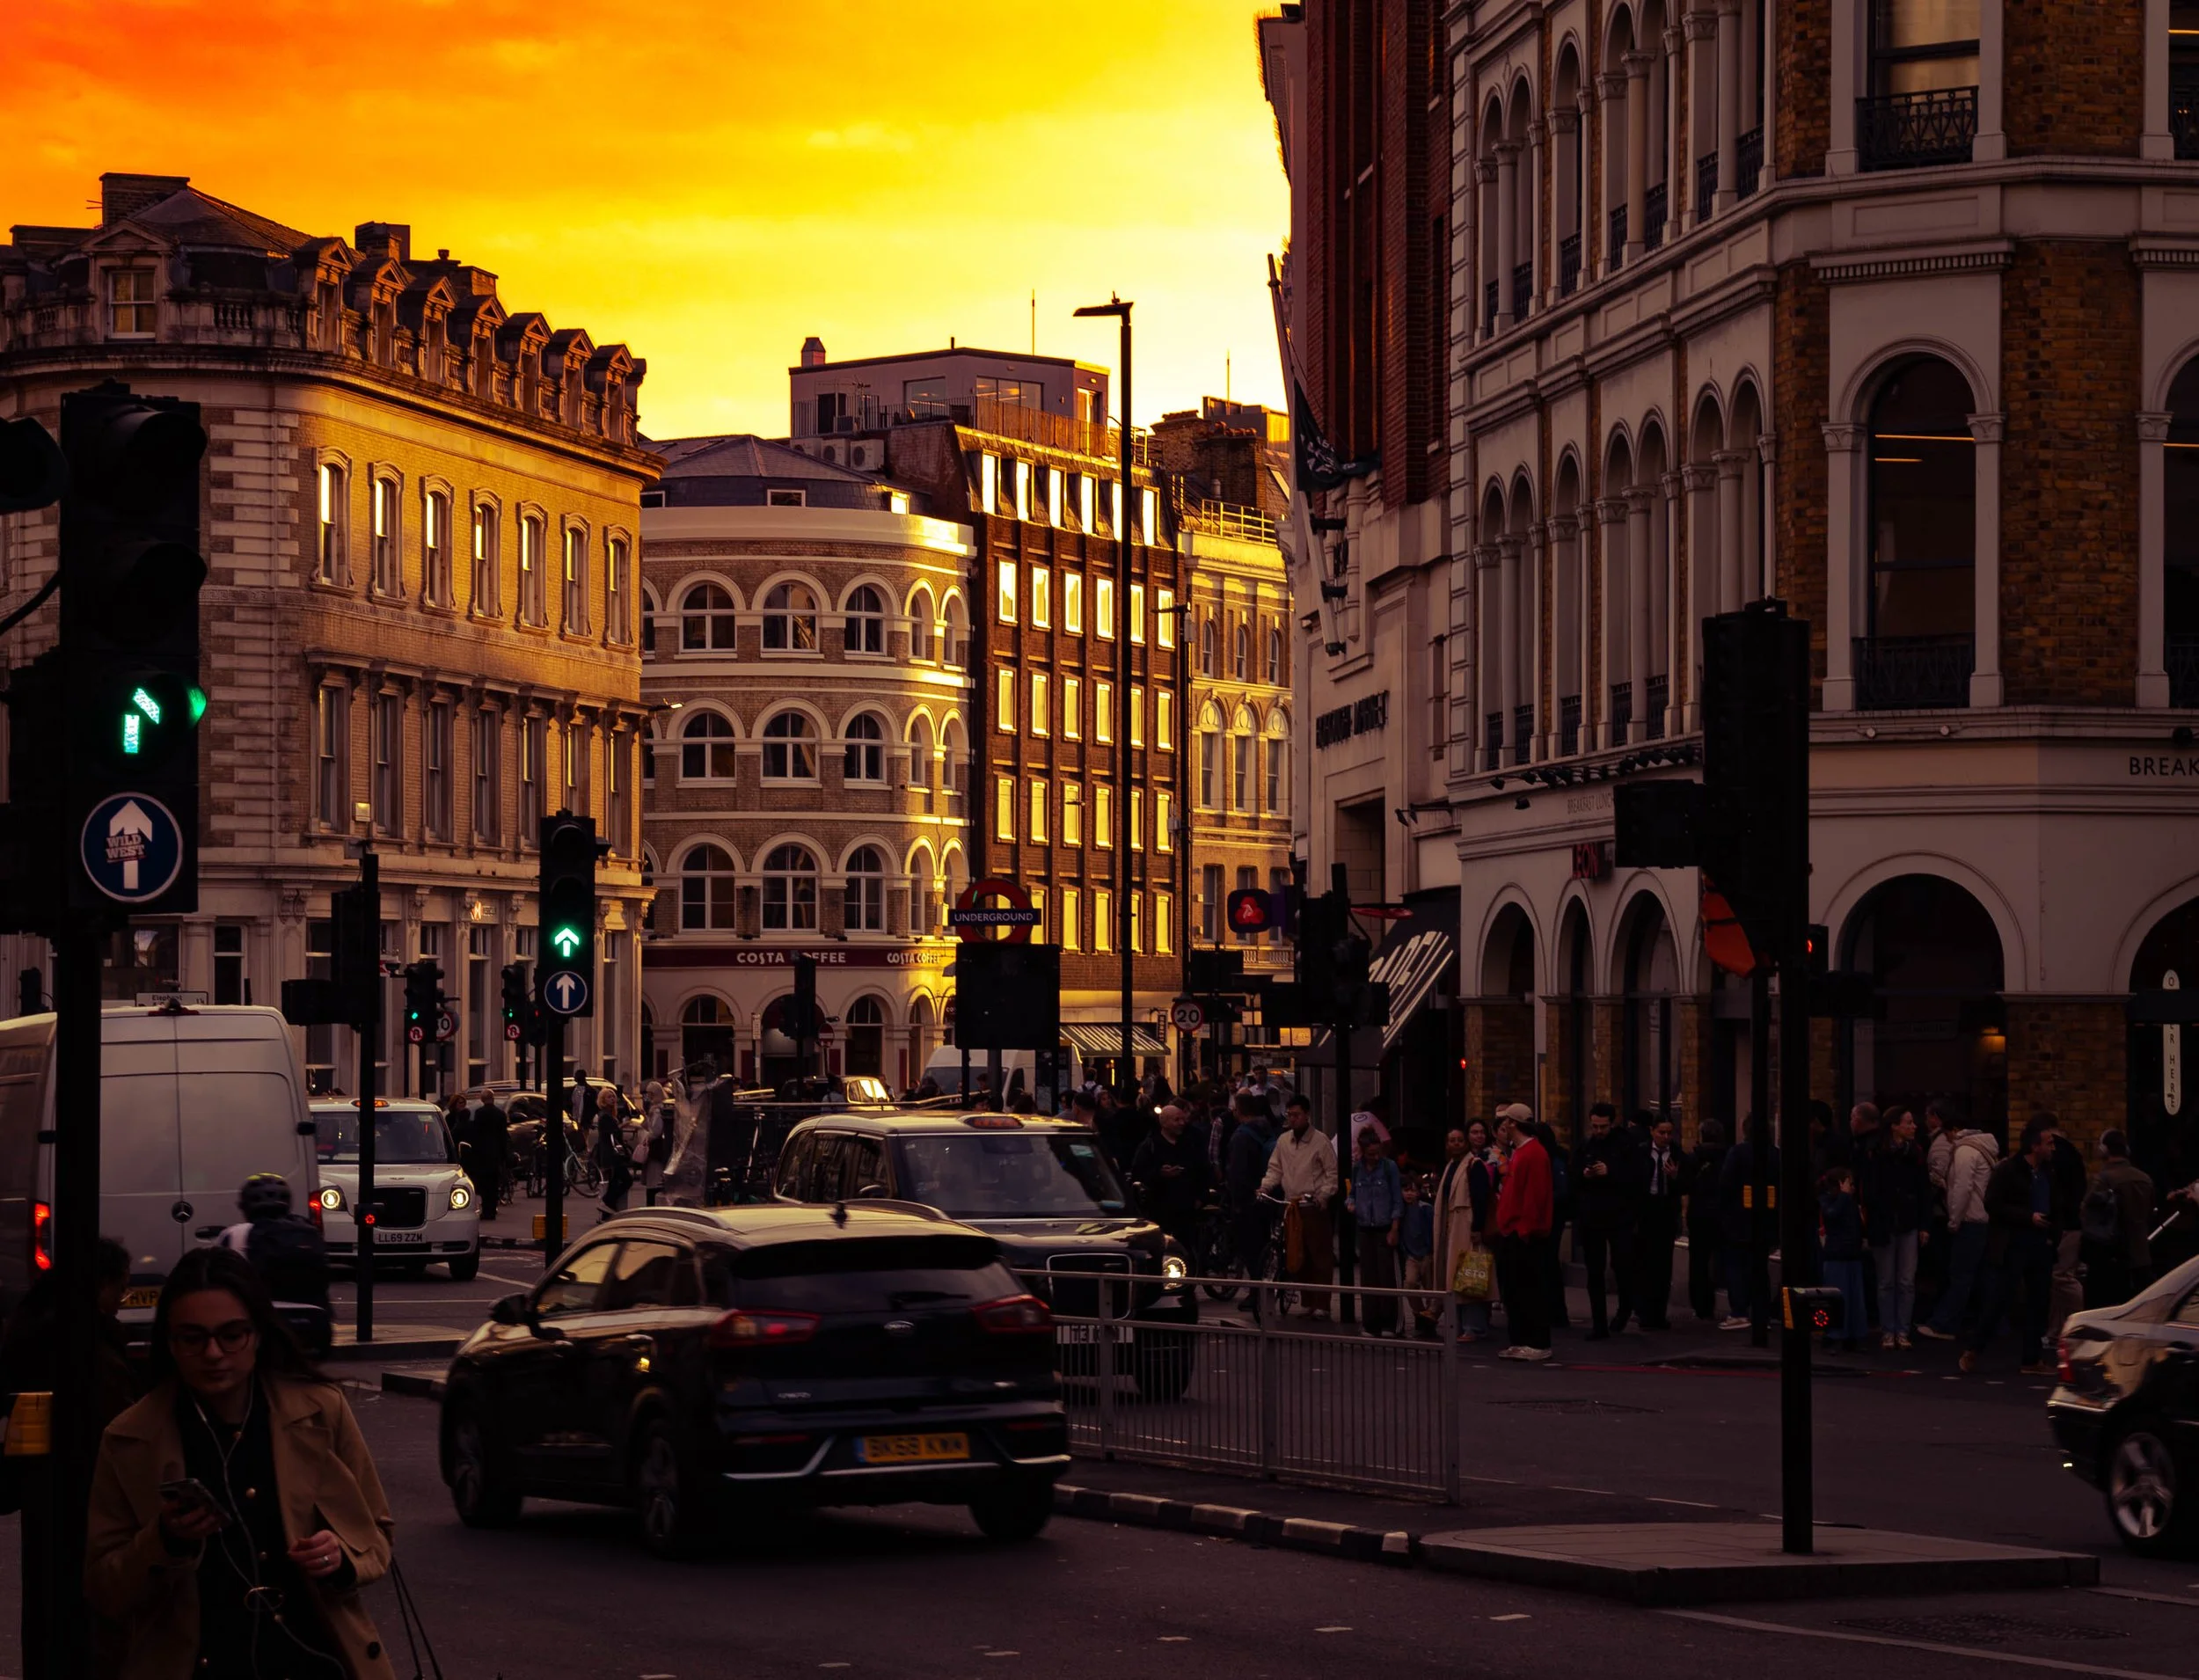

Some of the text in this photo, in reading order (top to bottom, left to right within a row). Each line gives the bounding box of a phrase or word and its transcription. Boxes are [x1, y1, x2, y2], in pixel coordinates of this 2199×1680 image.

[1596, 791, 1614, 810] LUNC
[106, 834, 142, 849] WILD
[106, 844, 146, 859] WEST
[954, 912, 1034, 922] UNDERGROUND
[736, 952, 785, 965] COSTA
[887, 953, 940, 965] COSTA COFFEE
[1177, 1010, 1199, 1023] 20
